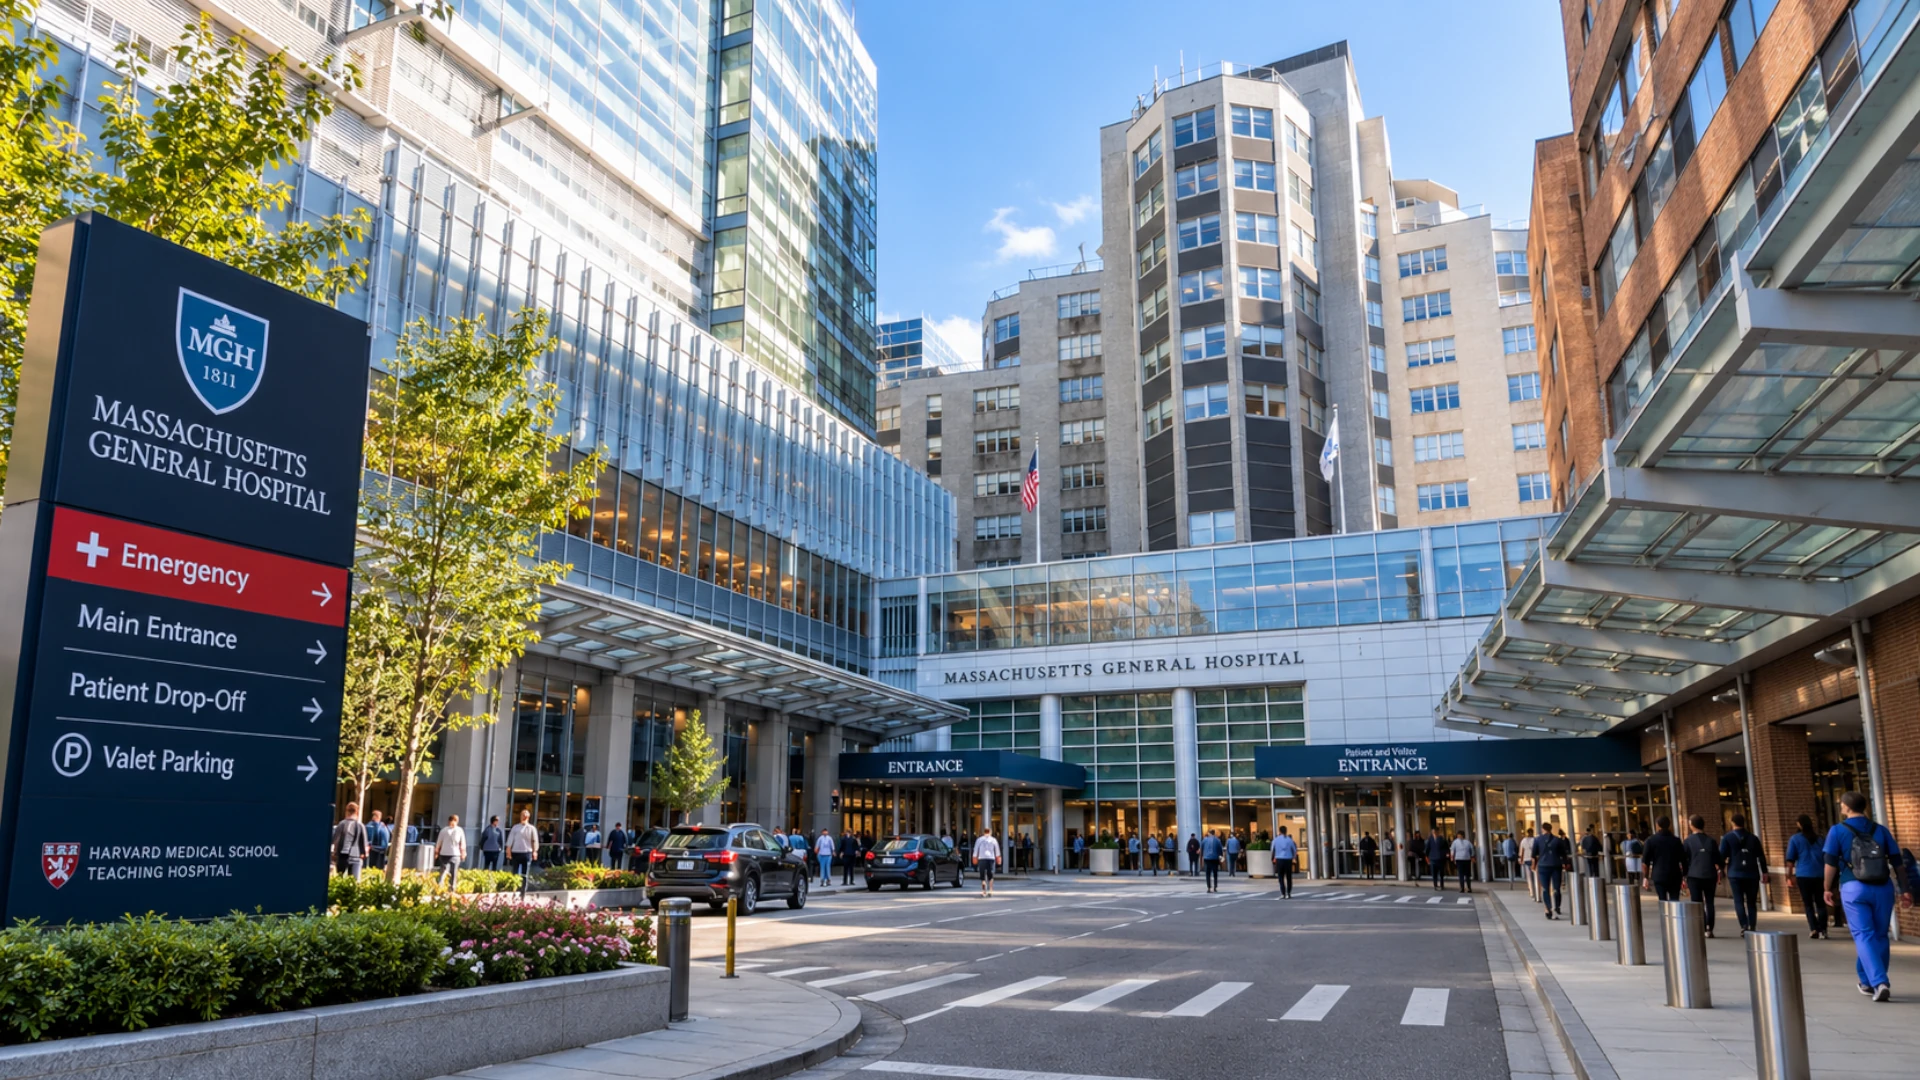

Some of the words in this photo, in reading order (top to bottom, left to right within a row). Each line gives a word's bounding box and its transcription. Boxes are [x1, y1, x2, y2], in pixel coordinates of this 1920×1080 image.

[187, 326, 256, 372] MGH
[203, 365, 236, 389] 1811
[92, 394, 307, 478] MASSACHUSETTS
[89, 430, 217, 486] GENERAL
[222, 465, 331, 515] HOSPITAL
[122, 543, 250, 594] Emergency
[78, 604, 139, 636] Main
[146, 615, 237, 649] Entrance
[944, 663, 1093, 685] MASSACHUSETTS
[1102, 657, 1196, 675] GENERAL
[1205, 651, 1304, 669] HOSPITAL
[69, 672, 149, 703] Patient
[155, 682, 247, 714] Drop-Off
[103, 745, 156, 771] Valet
[161, 749, 234, 780] Parking
[888, 759, 964, 774] ENTRANCE
[1338, 757, 1428, 772] ENTRANCE
[1375, 747, 1391, 757] and
[89, 845, 161, 859] HARVARD
[165, 845, 225, 859] MEDICAL
[228, 845, 279, 858] SCHOOL
[87, 865, 163, 880] TEACHING
[168, 864, 232, 878] HOSPITAL
